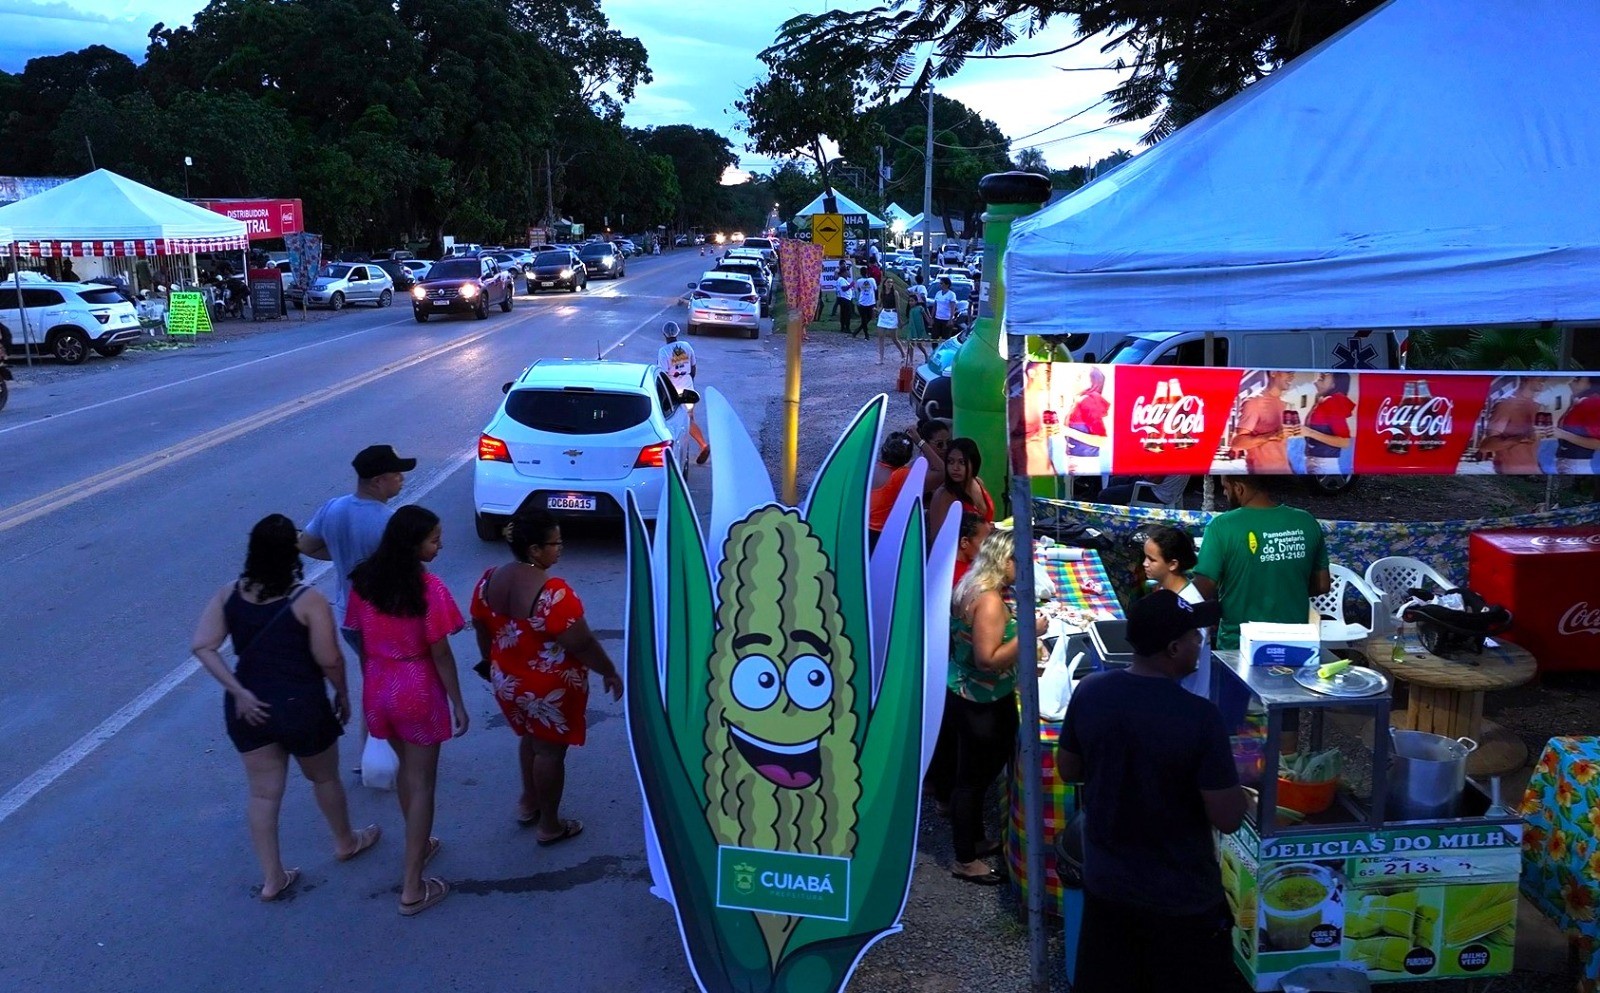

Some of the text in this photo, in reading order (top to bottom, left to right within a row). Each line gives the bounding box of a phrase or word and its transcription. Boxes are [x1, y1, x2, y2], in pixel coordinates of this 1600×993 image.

[227, 209, 269, 219] DISTRIBUIDORA
[843, 216, 864, 224] NHA
[246, 219, 271, 234] TRAL
[1262, 528, 1304, 539] Pamonharia
[1274, 535, 1305, 544] Pastelaria
[1530, 534, 1600, 546] Coca-C
[1262, 541, 1306, 554] do Divino
[1261, 837, 1387, 858] DELICIAS
[1393, 835, 1432, 850] DO
[1437, 832, 1506, 849] MILH
[1359, 869, 1376, 877] 65
[760, 873, 834, 894] CUIABÁ
[1460, 952, 1488, 962] MILHO
[1461, 959, 1486, 970] VERDE
